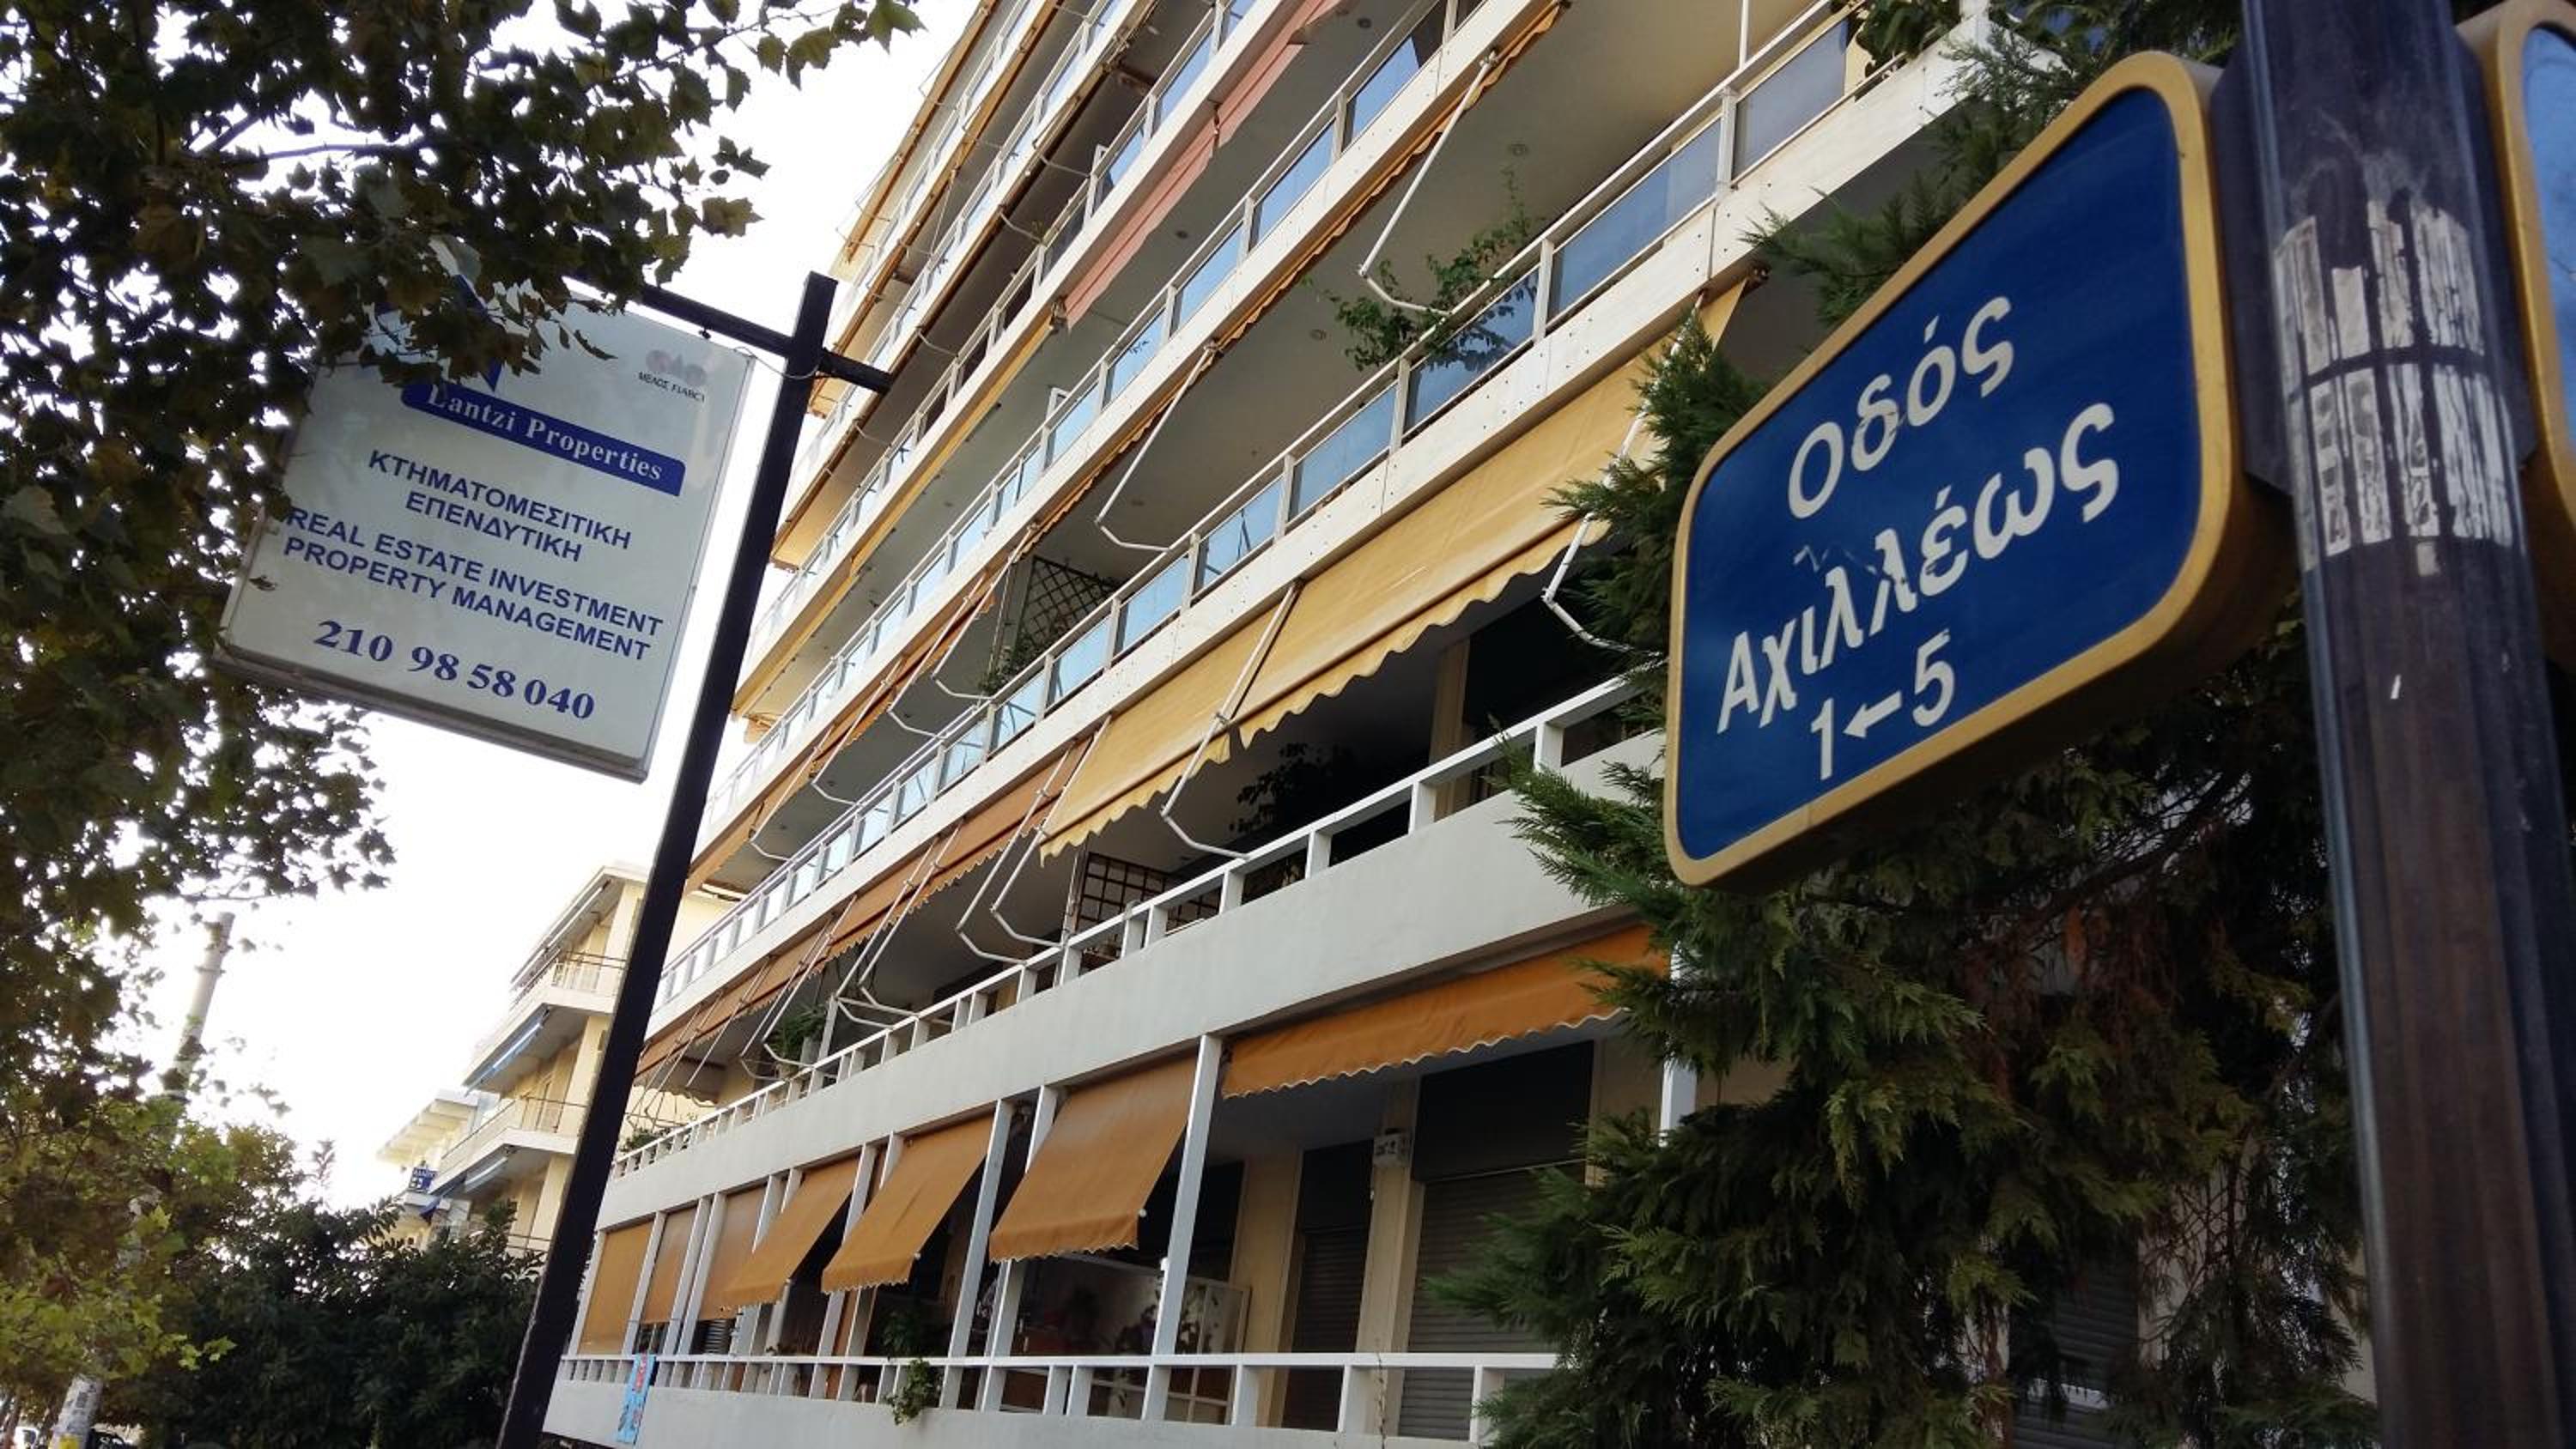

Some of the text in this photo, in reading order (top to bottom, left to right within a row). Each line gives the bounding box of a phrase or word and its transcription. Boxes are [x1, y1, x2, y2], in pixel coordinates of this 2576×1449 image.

[428, 383, 663, 482] Lantzi Properties
[1788, 296, 2014, 520] Οδός
[368, 450, 632, 549] ΚΤΗΜΑΤΟΜΕΣΙΤΙΚΗ
[405, 491, 581, 562] ΕΠΕΝΔΥΤΙΚΗ
[283, 537, 652, 661] PROPERTY MANAGEMENT
[288, 507, 664, 637] REAL ESTATE INVESTMENT
[1717, 403, 2120, 735] Αχιλλέως
[313, 620, 393, 662] 210
[1810, 631, 1956, 780] 1 5
